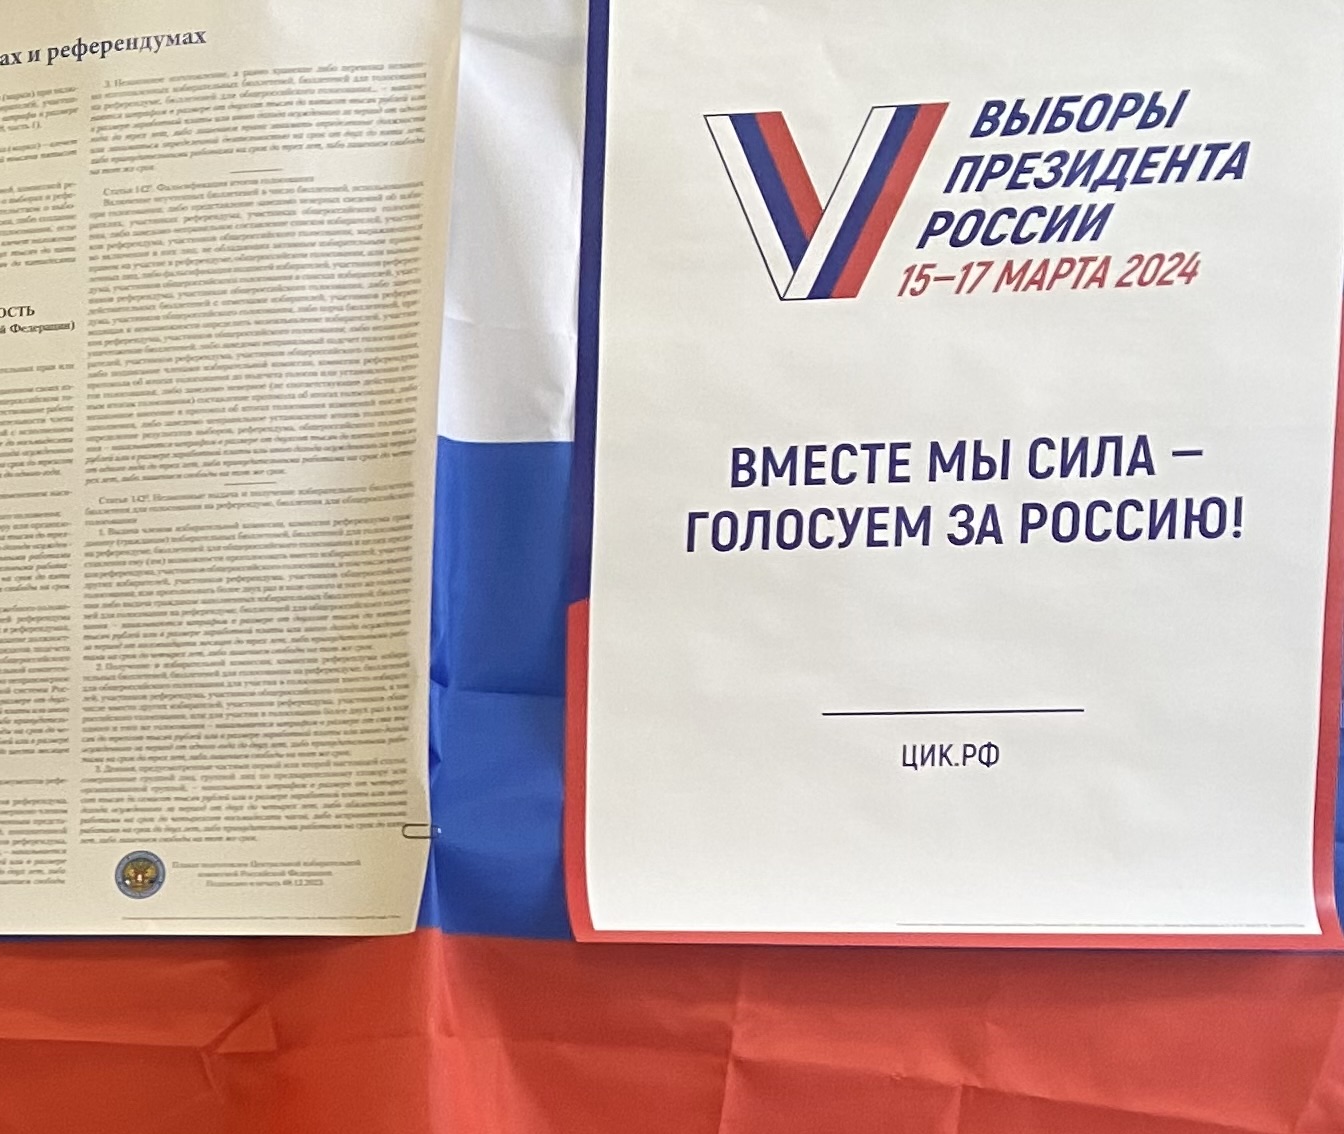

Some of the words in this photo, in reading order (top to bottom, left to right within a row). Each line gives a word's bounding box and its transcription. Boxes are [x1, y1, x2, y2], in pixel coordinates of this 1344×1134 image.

[27, 48, 42, 62] и
[47, 30, 208, 65] референдумах
[969, 88, 1191, 138] ВЫБОРЫ
[943, 142, 1252, 194] ПРЕЗИДЕНТА
[915, 202, 1115, 249] РОССИИ
[994, 255, 1111, 294] МАРТА
[1115, 251, 1201, 288] 2024
[731, 442, 912, 488] ВМЕСТЕ
[927, 439, 1011, 483] МЫ
[1027, 434, 1156, 479] СИЛА
[686, 504, 931, 553] ГОЛОСУЕМ
[946, 504, 1003, 546] ЗА
[1020, 495, 1245, 545] РОССИЮ!
[901, 741, 1001, 771] ЦИК.РФ
